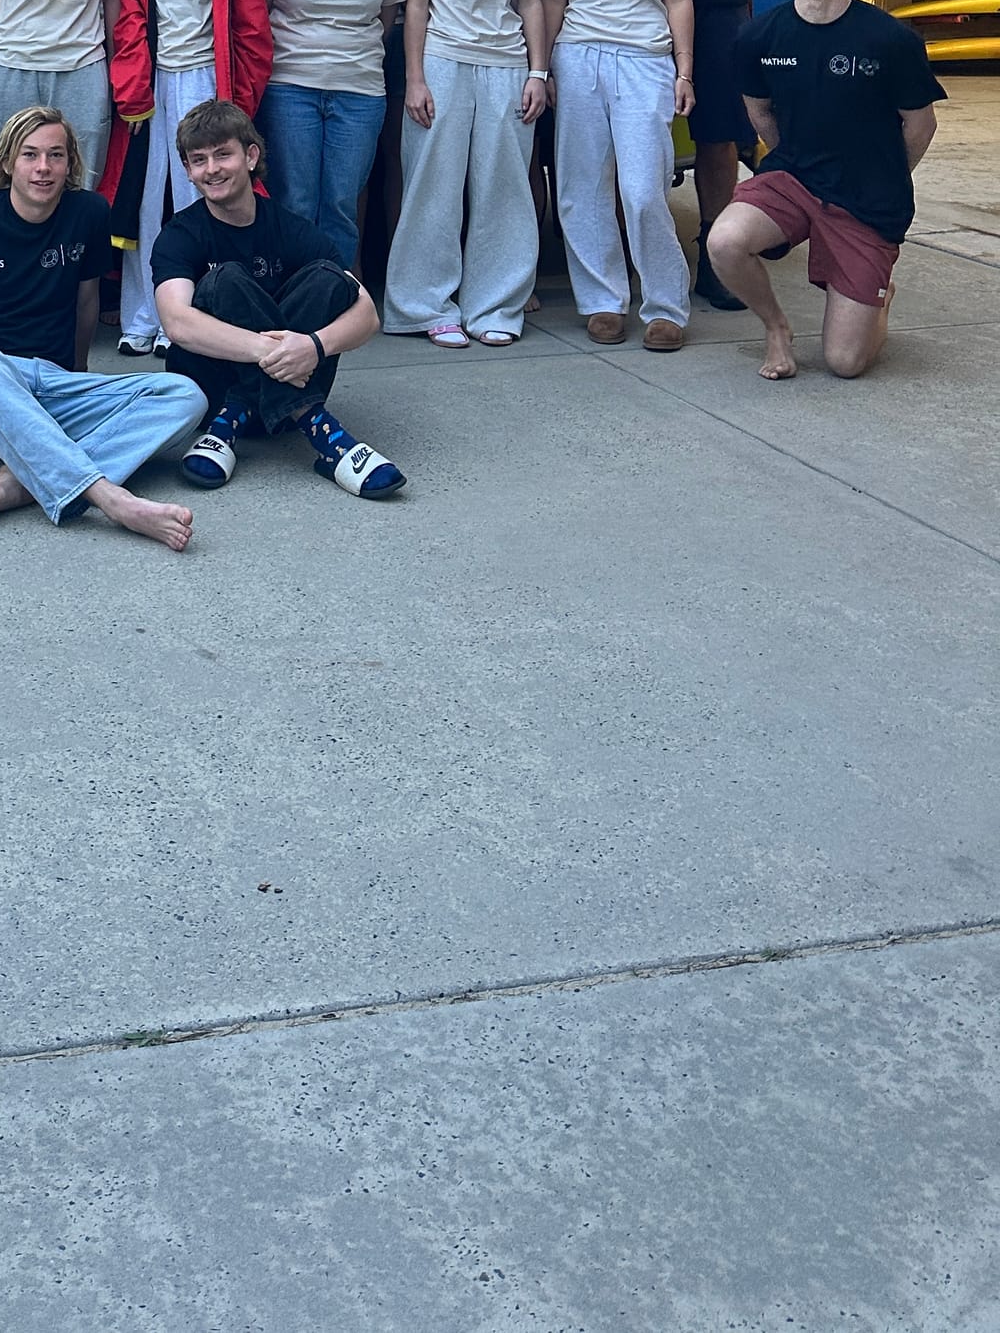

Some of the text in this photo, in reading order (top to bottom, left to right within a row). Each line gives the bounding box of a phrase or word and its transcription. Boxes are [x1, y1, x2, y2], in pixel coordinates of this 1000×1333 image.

[760, 57, 798, 66] MATHIAS
[200, 437, 225, 452] NIKE
[350, 447, 371, 466] NIKE
